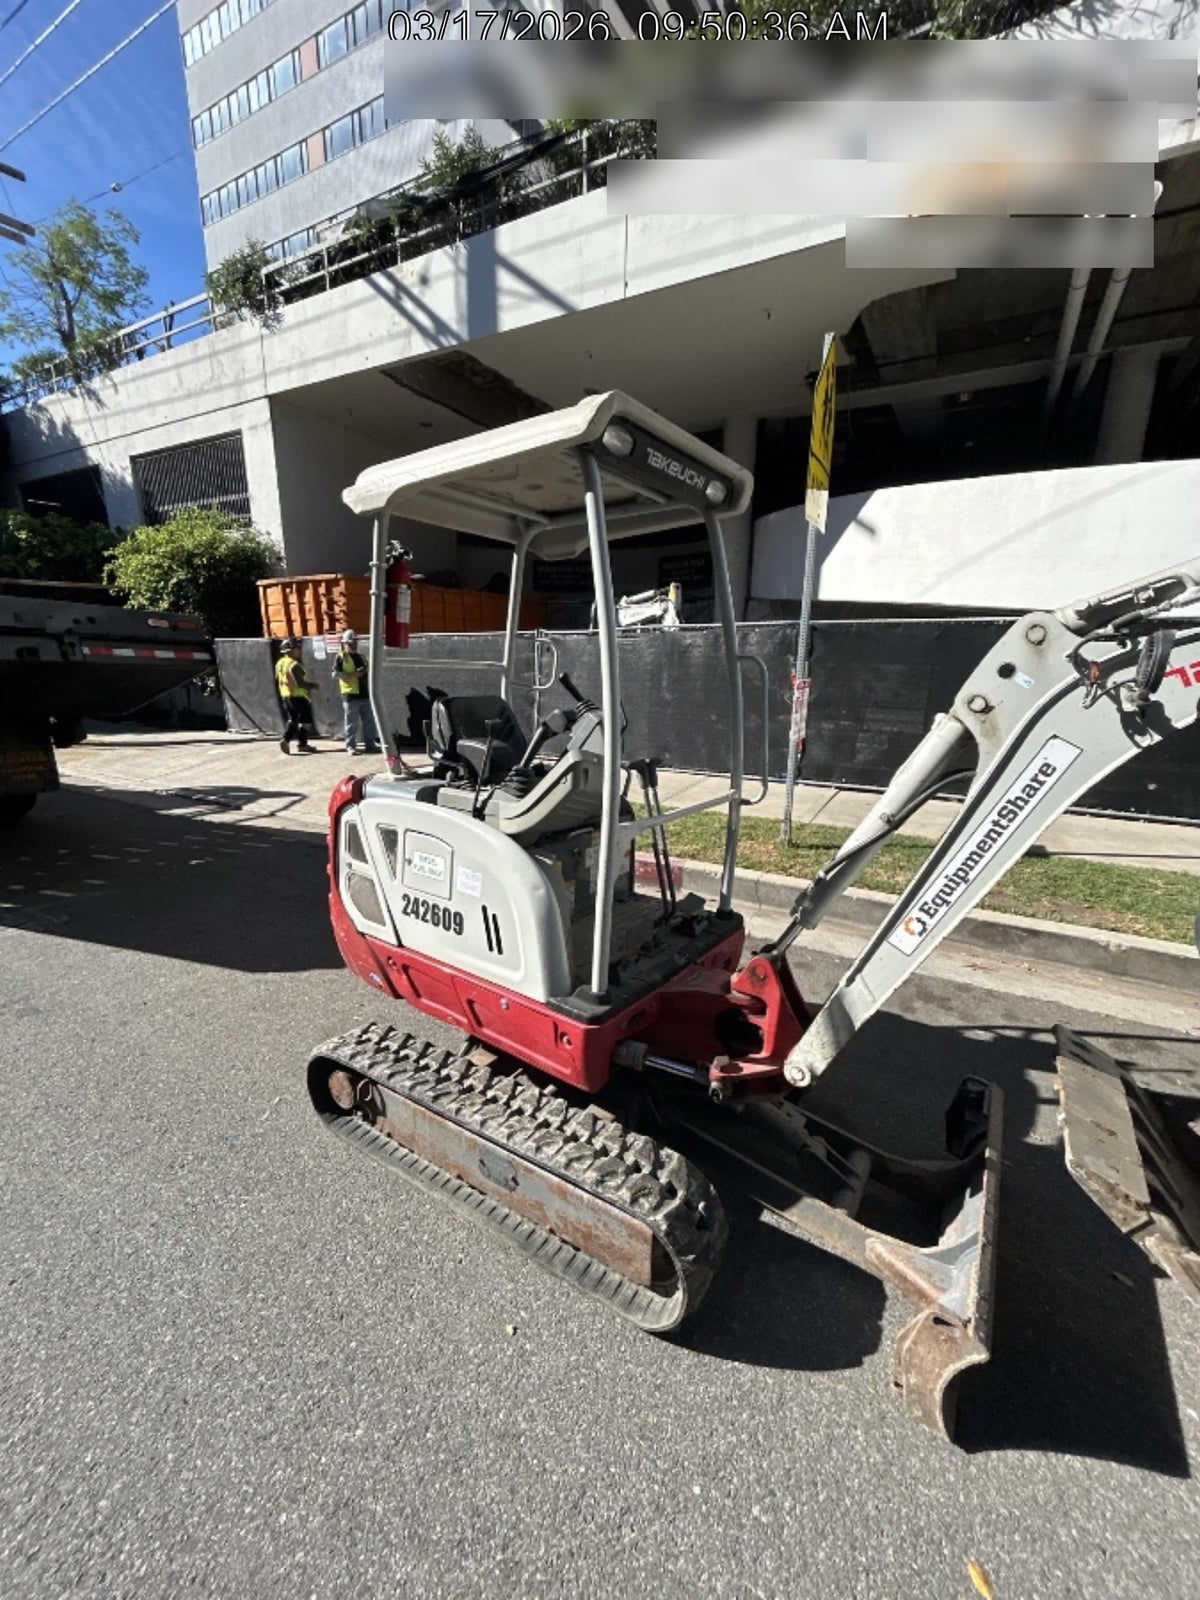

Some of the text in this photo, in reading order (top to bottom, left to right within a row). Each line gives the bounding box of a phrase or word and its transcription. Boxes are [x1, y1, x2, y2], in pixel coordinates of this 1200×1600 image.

[646, 447, 706, 489] TAKEUCHI
[919, 761, 1057, 919] EquipmentShare
[401, 893, 464, 936] 242609
